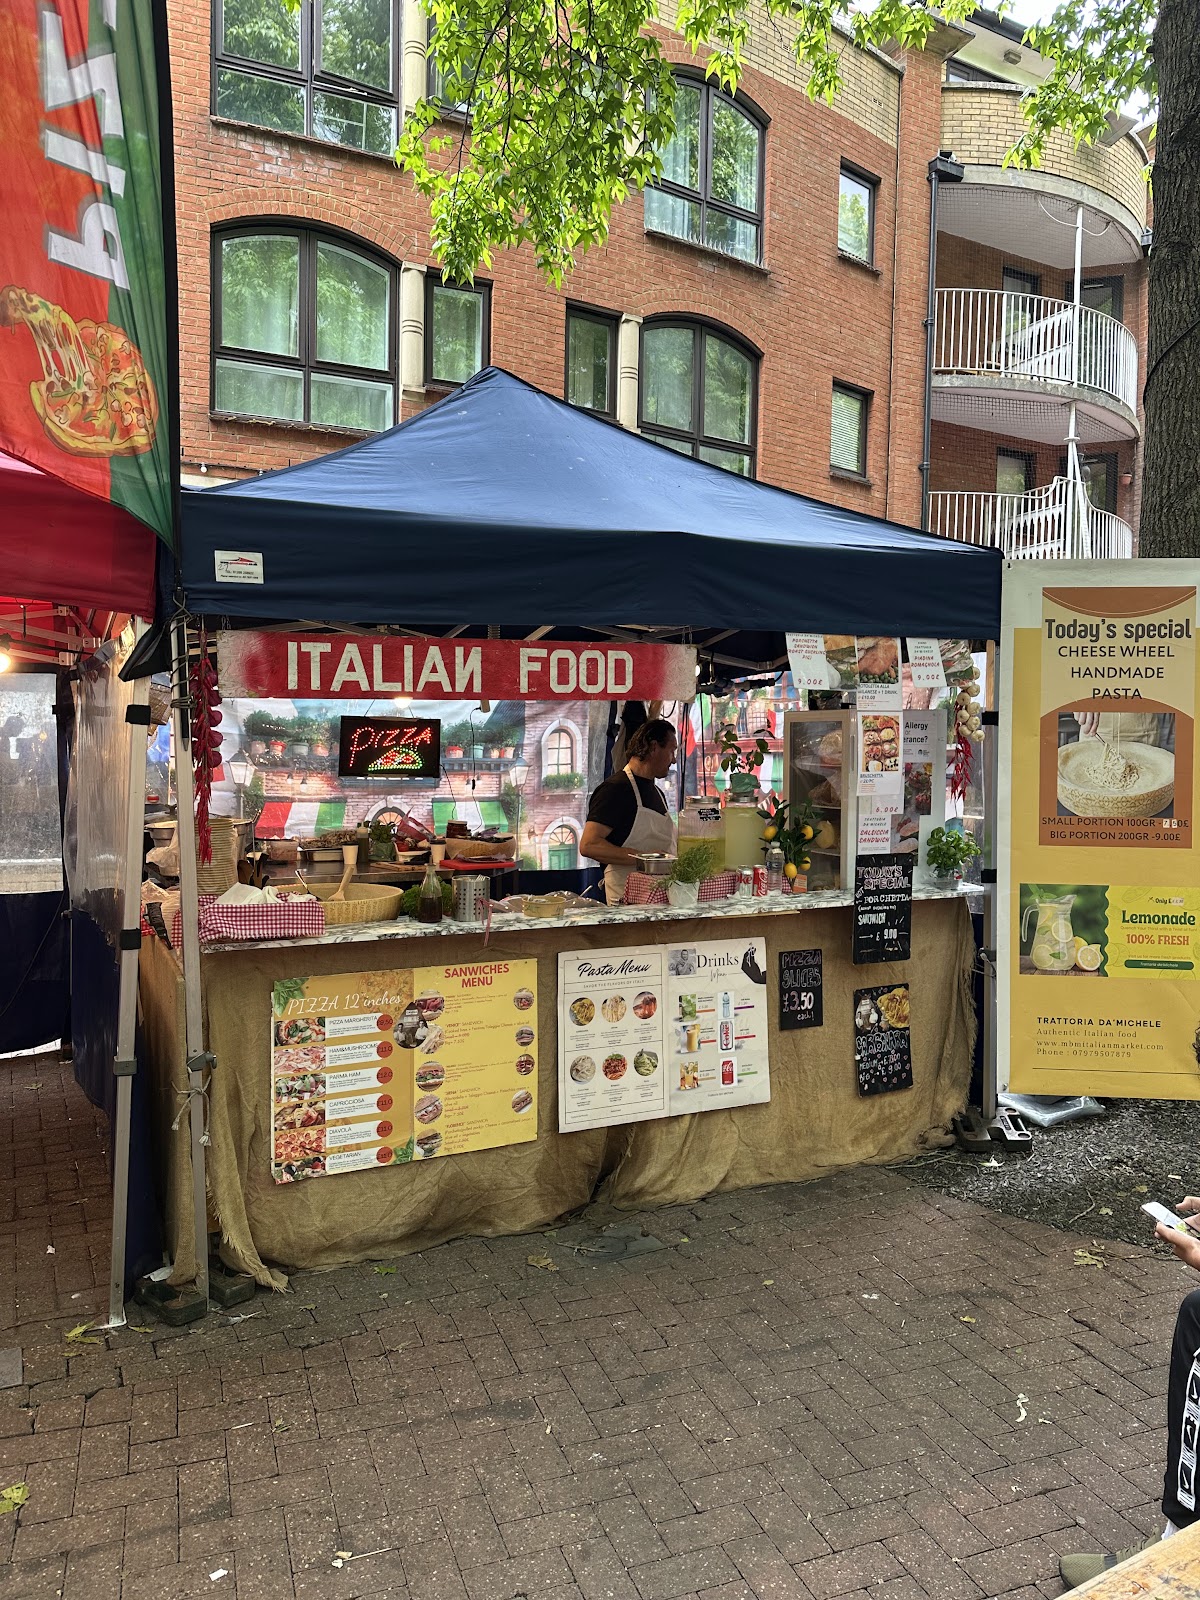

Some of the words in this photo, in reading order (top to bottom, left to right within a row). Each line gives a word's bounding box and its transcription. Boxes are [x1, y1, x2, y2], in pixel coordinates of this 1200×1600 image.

[1045, 618, 1117, 643] Today's
[1124, 618, 1192, 643] special
[1058, 646, 1116, 658] CHEESE
[1120, 646, 1175, 658] WHEEL
[287, 641, 482, 693] ITALIAN
[519, 647, 634, 695] FOOD
[1071, 666, 1164, 679] HANDMADE
[798, 678, 823, 686] 9.00£
[1092, 688, 1142, 700] PASTA
[904, 722, 929, 730] Allergy
[349, 726, 432, 768] PIZZA
[1042, 817, 1075, 826] SMALL
[1078, 818, 1124, 826] PORTION
[1126, 819, 1156, 827] 100GR
[1050, 831, 1067, 839] BIG
[1069, 832, 1116, 840] PORTION
[1118, 832, 1149, 840] 200GR
[856, 864, 903, 879] TODAY'S
[864, 877, 911, 890] SPECIAL
[858, 913, 886, 926] SANDWICH
[1122, 910, 1196, 925] Lemonade
[884, 928, 898, 940] 9.00
[1126, 934, 1156, 945] 100%
[1158, 935, 1190, 946] FRESH
[697, 952, 739, 968] Drinks
[782, 951, 821, 969] PIZZA
[444, 964, 510, 979] SANWICHES
[578, 962, 615, 978] Pasta
[614, 960, 651, 976] Menu
[462, 976, 493, 988] MENU
[782, 968, 821, 989] SLICES
[288, 995, 339, 1015] PIZZA
[364, 991, 401, 1007] inches
[1037, 1017, 1094, 1026] TRATTORIA
[1037, 1028, 1081, 1036] Authentic
[1084, 1030, 1114, 1038] Italian
[1118, 1030, 1137, 1038] food
[1037, 1040, 1164, 1050] www.mbmitalianmarket.com
[1036, 1048, 1064, 1056] Phone
[1072, 1050, 1132, 1058] 07979507879
[329, 1152, 361, 1160] VEGETARIAN
